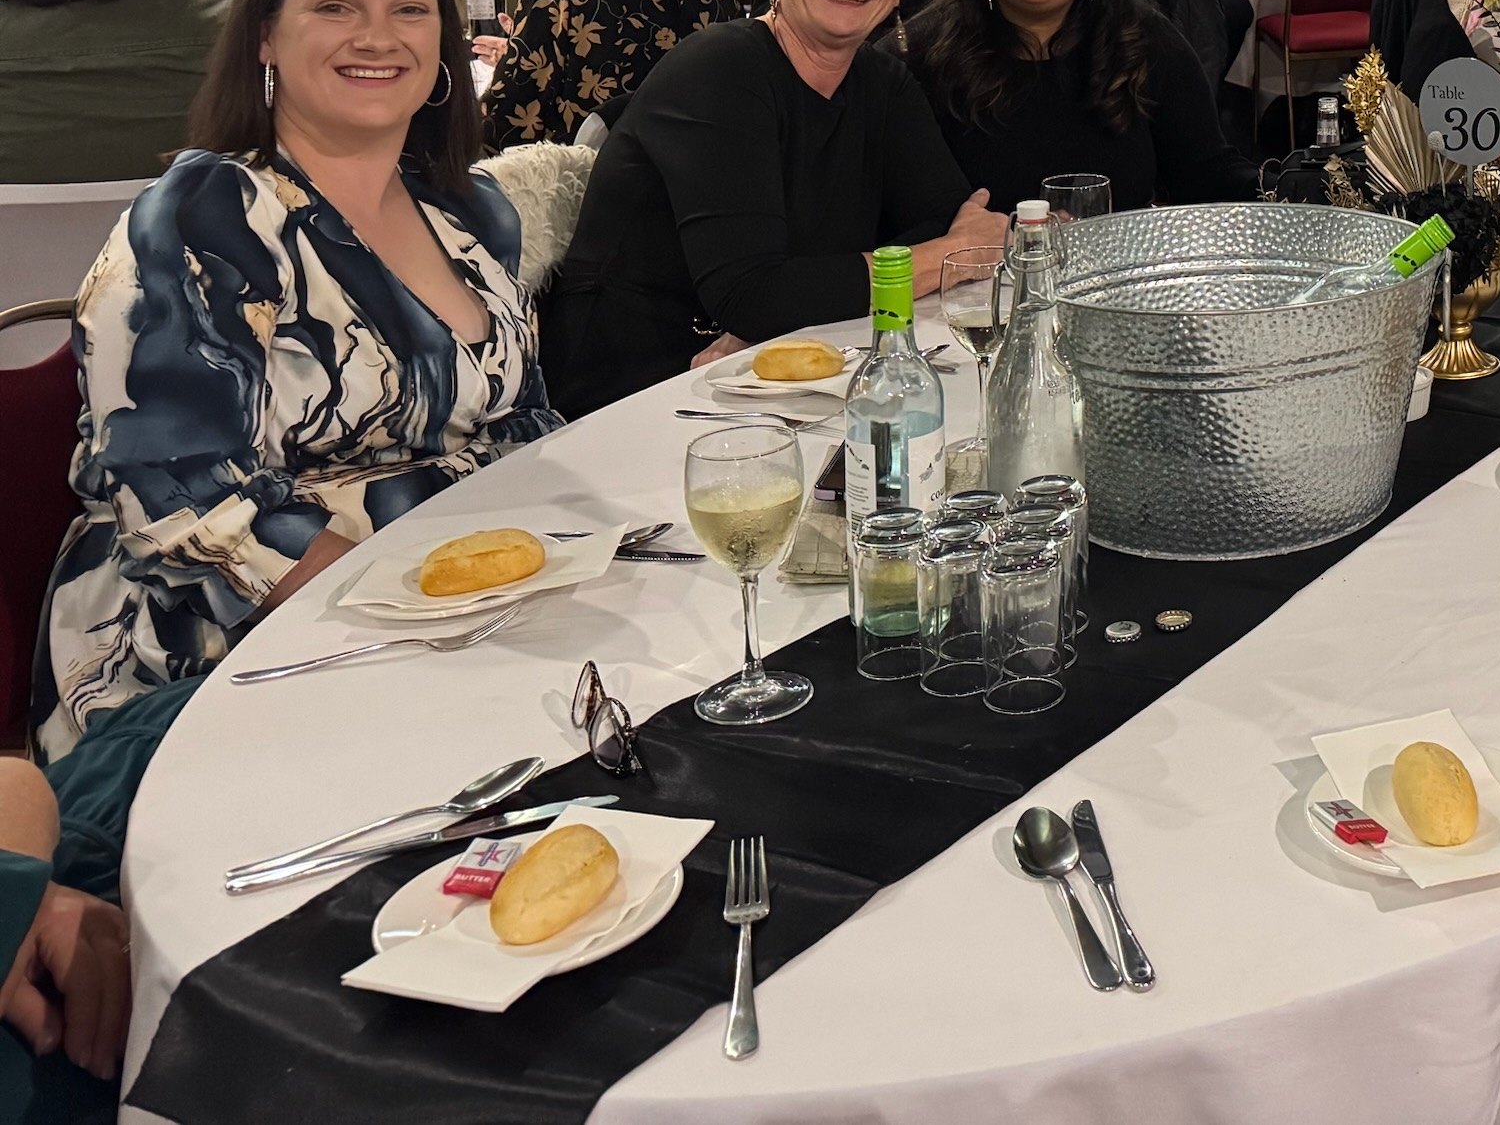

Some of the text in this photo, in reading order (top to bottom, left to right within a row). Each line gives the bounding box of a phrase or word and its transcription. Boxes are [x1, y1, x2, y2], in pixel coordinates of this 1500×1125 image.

[1428, 85, 1465, 100] Table
[1442, 107, 1500, 152] 30
[453, 873, 492, 883] BUTTER
